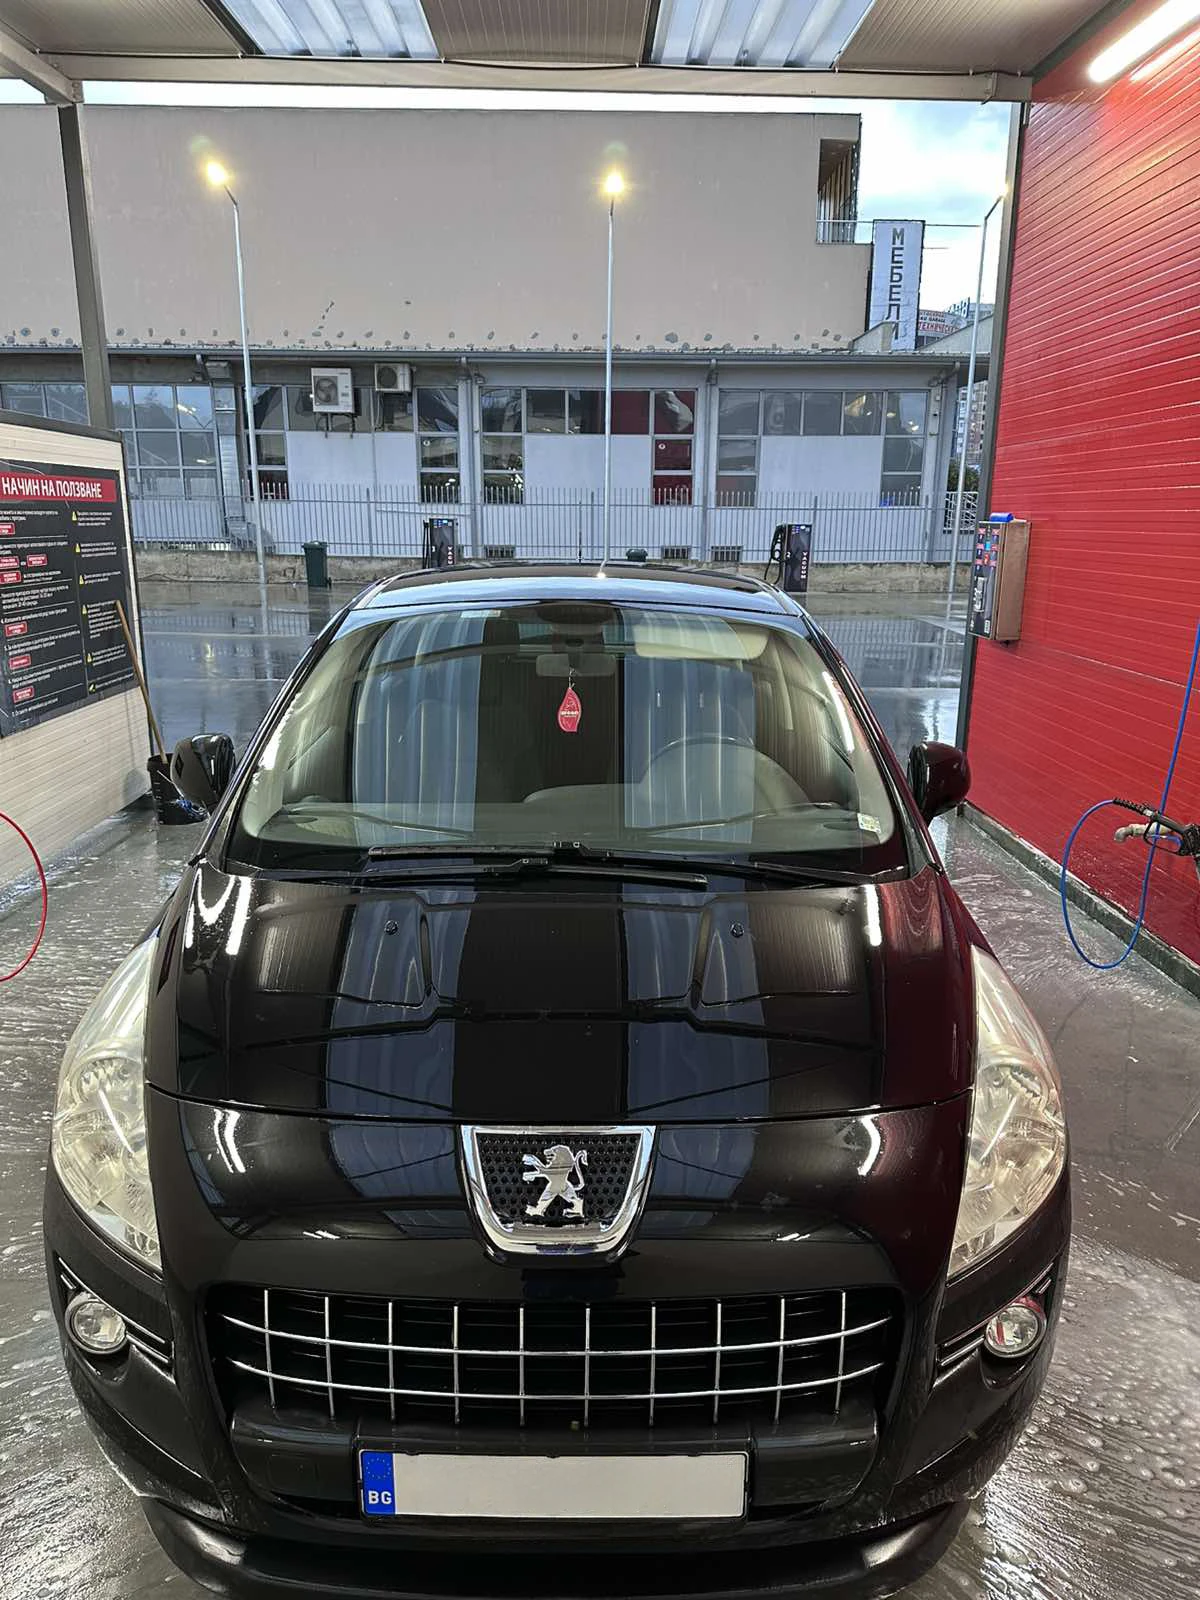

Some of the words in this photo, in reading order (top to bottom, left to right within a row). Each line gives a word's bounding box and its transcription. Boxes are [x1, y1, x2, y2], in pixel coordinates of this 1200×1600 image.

[2, 477, 40, 495] НАЧИН
[41, 480, 56, 496] НА
[56, 481, 102, 498] ПОЛЗВАНЕ
[800, 552, 808, 579] VACUUM
[368, 1490, 392, 1504] BG
